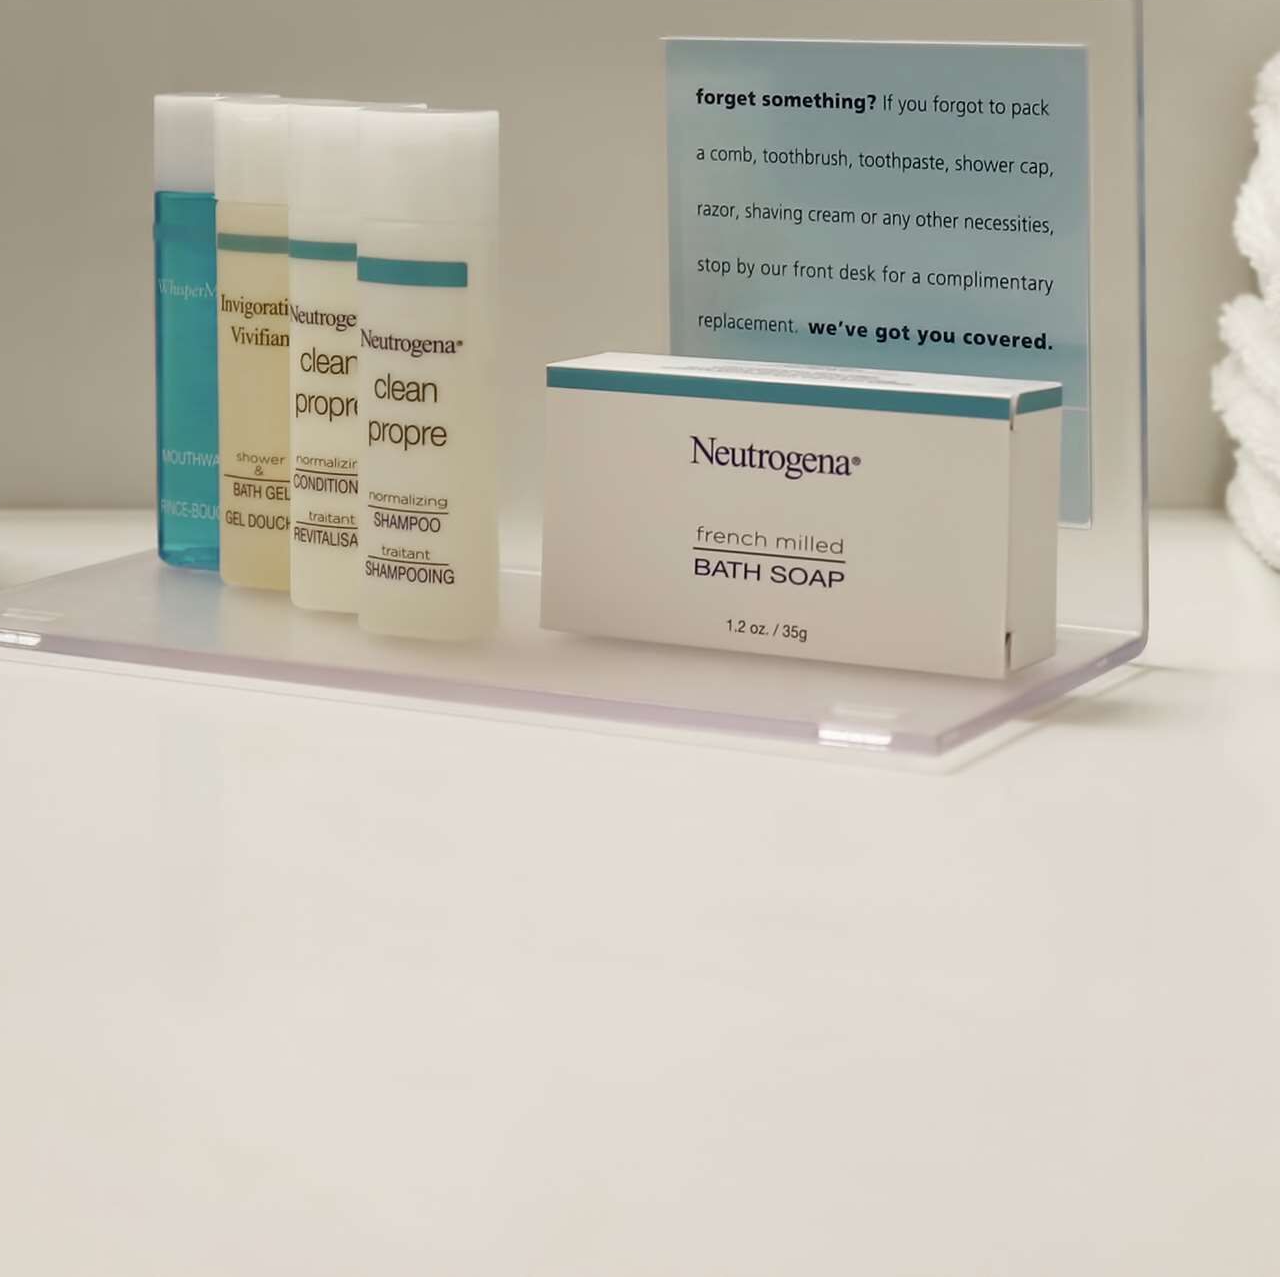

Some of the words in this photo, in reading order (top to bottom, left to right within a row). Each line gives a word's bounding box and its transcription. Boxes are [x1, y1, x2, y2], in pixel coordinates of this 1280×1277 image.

[695, 87, 757, 110] forget
[762, 91, 877, 114] something?
[883, 93, 894, 111] If
[898, 99, 927, 116] you
[932, 94, 984, 118] forgot
[988, 98, 1006, 115] to
[1011, 98, 1050, 119] pack
[696, 148, 705, 161] a
[710, 145, 757, 165] comb,
[762, 147, 853, 169] toothbrush,
[858, 151, 949, 174] toothpaste,
[954, 154, 1015, 174] shower
[1019, 161, 1054, 179] cap,
[697, 203, 739, 221] razor,
[744, 202, 803, 226] shaving
[807, 209, 856, 224] cream
[860, 211, 878, 225] or
[882, 212, 911, 231] any
[915, 210, 959, 229] other
[964, 214, 1054, 236] necessities,
[697, 257, 731, 277] stop
[736, 257, 756, 279] by
[760, 263, 788, 277] our
[792, 260, 833, 280] front
[839, 263, 876, 282] desk
[881, 265, 906, 283] for
[911, 271, 921, 285] a
[926, 270, 1054, 297] complimentary
[220, 293, 288, 319] Invigorati
[289, 304, 357, 332] Neutroge
[231, 325, 289, 347] Vivifian
[698, 312, 799, 334] replacement.
[875, 325, 911, 344] got
[917, 329, 956, 346] you
[962, 332, 1053, 351] covered.
[374, 372, 438, 403] clean
[368, 420, 448, 452] propre
[235, 450, 286, 466] shower
[254, 465, 264, 476] &
[233, 481, 262, 499] BATH
[265, 485, 291, 501] GEL
[293, 473, 359, 494] CONDITION
[368, 490, 448, 509] normalizing
[225, 509, 245, 527] GEL
[308, 510, 356, 525] traitant
[374, 511, 441, 533] SHAMPOO
[294, 526, 359, 547] REVITALISA
[697, 525, 767, 547] french
[775, 535, 844, 555] milled
[381, 545, 431, 561] traitant
[365, 560, 455, 585] SHAMPOOING
[694, 557, 761, 582] BATH
[770, 565, 845, 589] SOAP
[727, 618, 746, 634] 1.2
[749, 623, 769, 636] oz.
[772, 623, 780, 637] /
[782, 624, 808, 643] 35g
